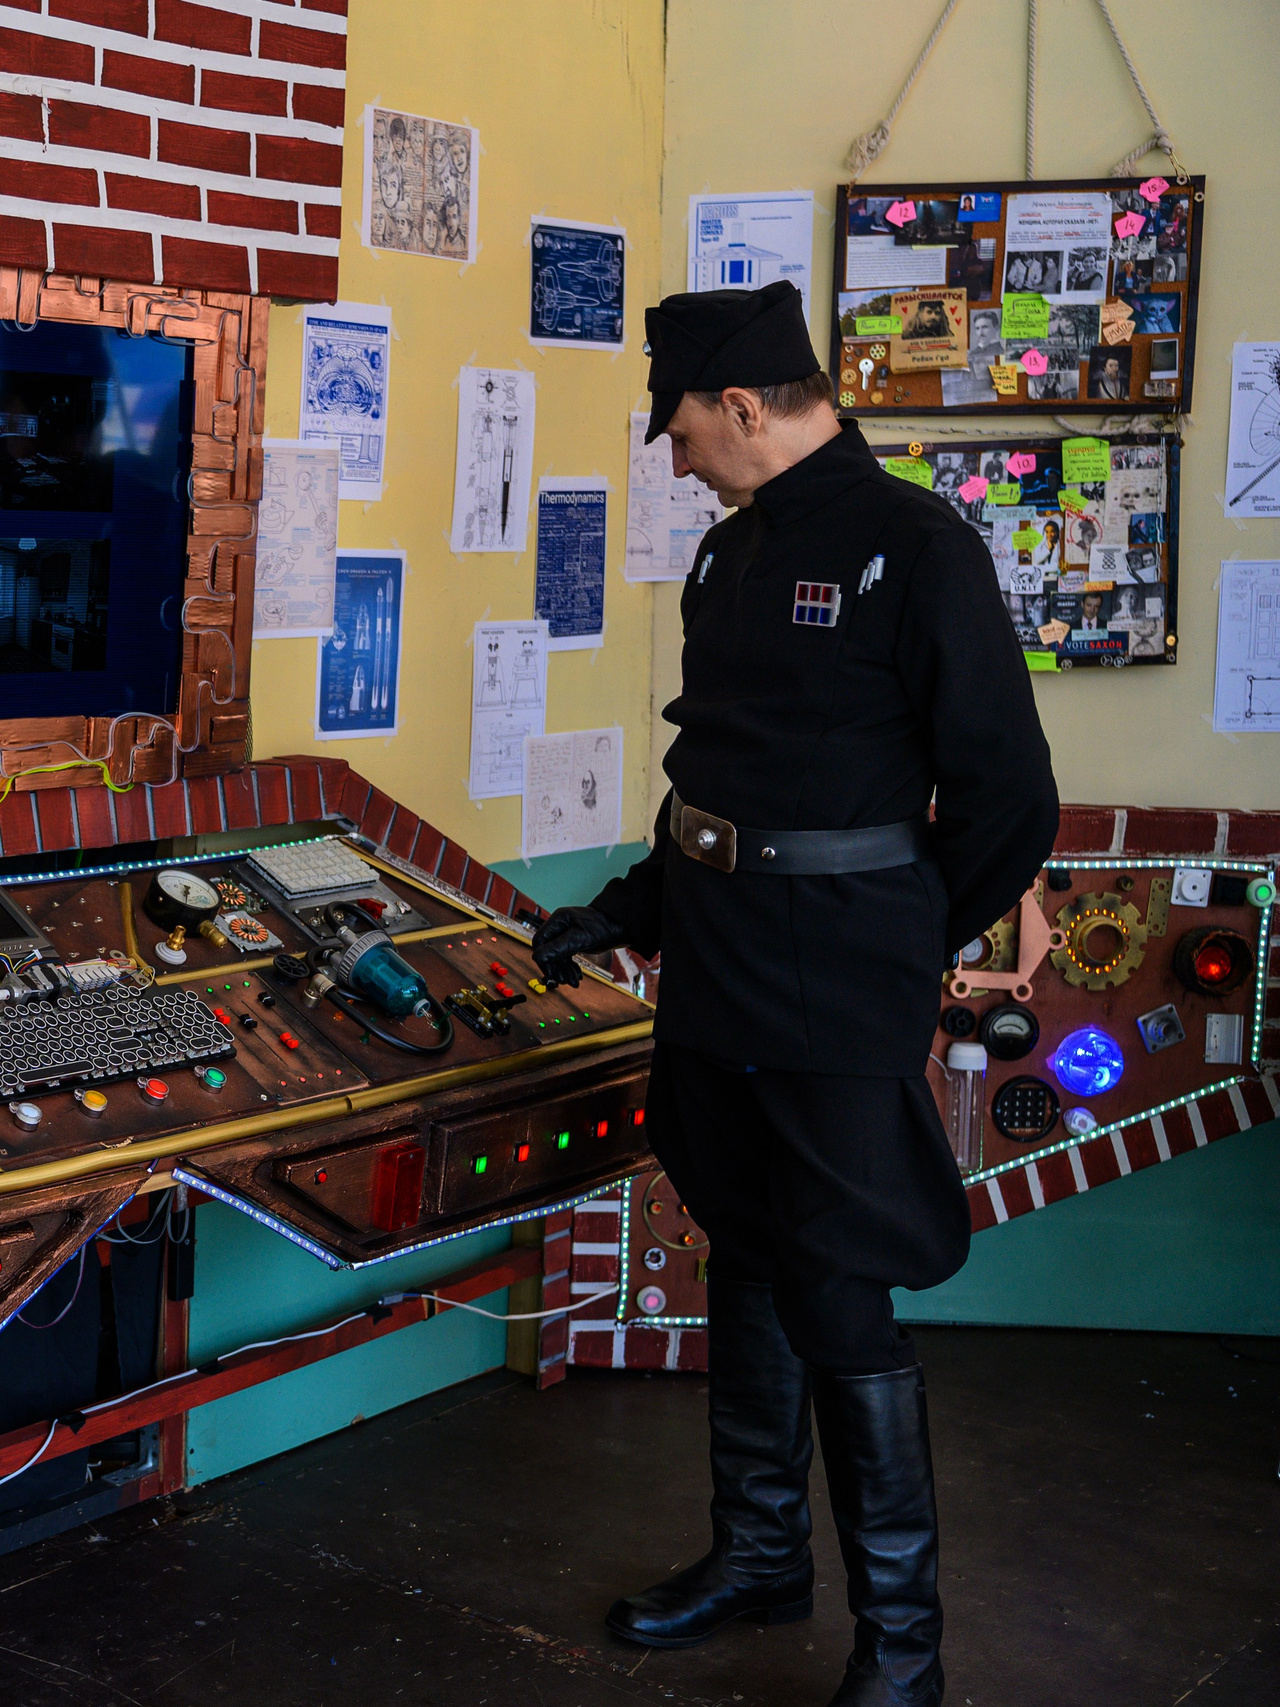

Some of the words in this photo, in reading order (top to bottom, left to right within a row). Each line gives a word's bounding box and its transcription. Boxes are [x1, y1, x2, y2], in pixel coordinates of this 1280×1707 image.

[900, 207, 910, 218] 12
[1125, 220, 1135, 230] 14
[894, 292, 963, 304] РАЗЫСКИВАЕТСЯ
[540, 491, 605, 507] Thermodynamics
